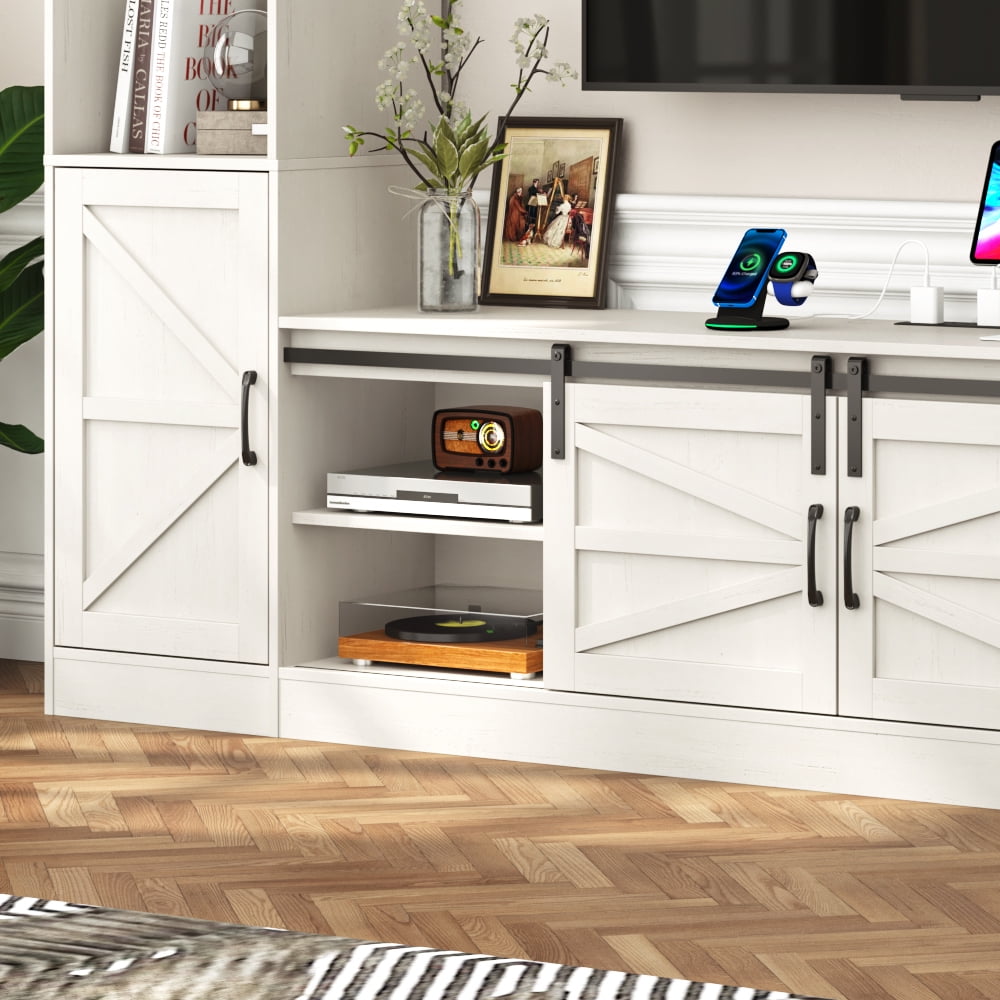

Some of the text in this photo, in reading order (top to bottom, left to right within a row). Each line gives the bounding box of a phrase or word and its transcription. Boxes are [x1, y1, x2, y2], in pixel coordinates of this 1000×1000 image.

[121, 0, 136, 72] LOST FISH
[158, 21, 169, 49] REDD
[156, 52, 166, 72] THE
[154, 75, 164, 103] BOOK
[196, 88, 224, 111] OF
[132, 68, 146, 139] CALLAS
[152, 105, 162, 119] OF
[151, 121, 161, 146] CHIC
